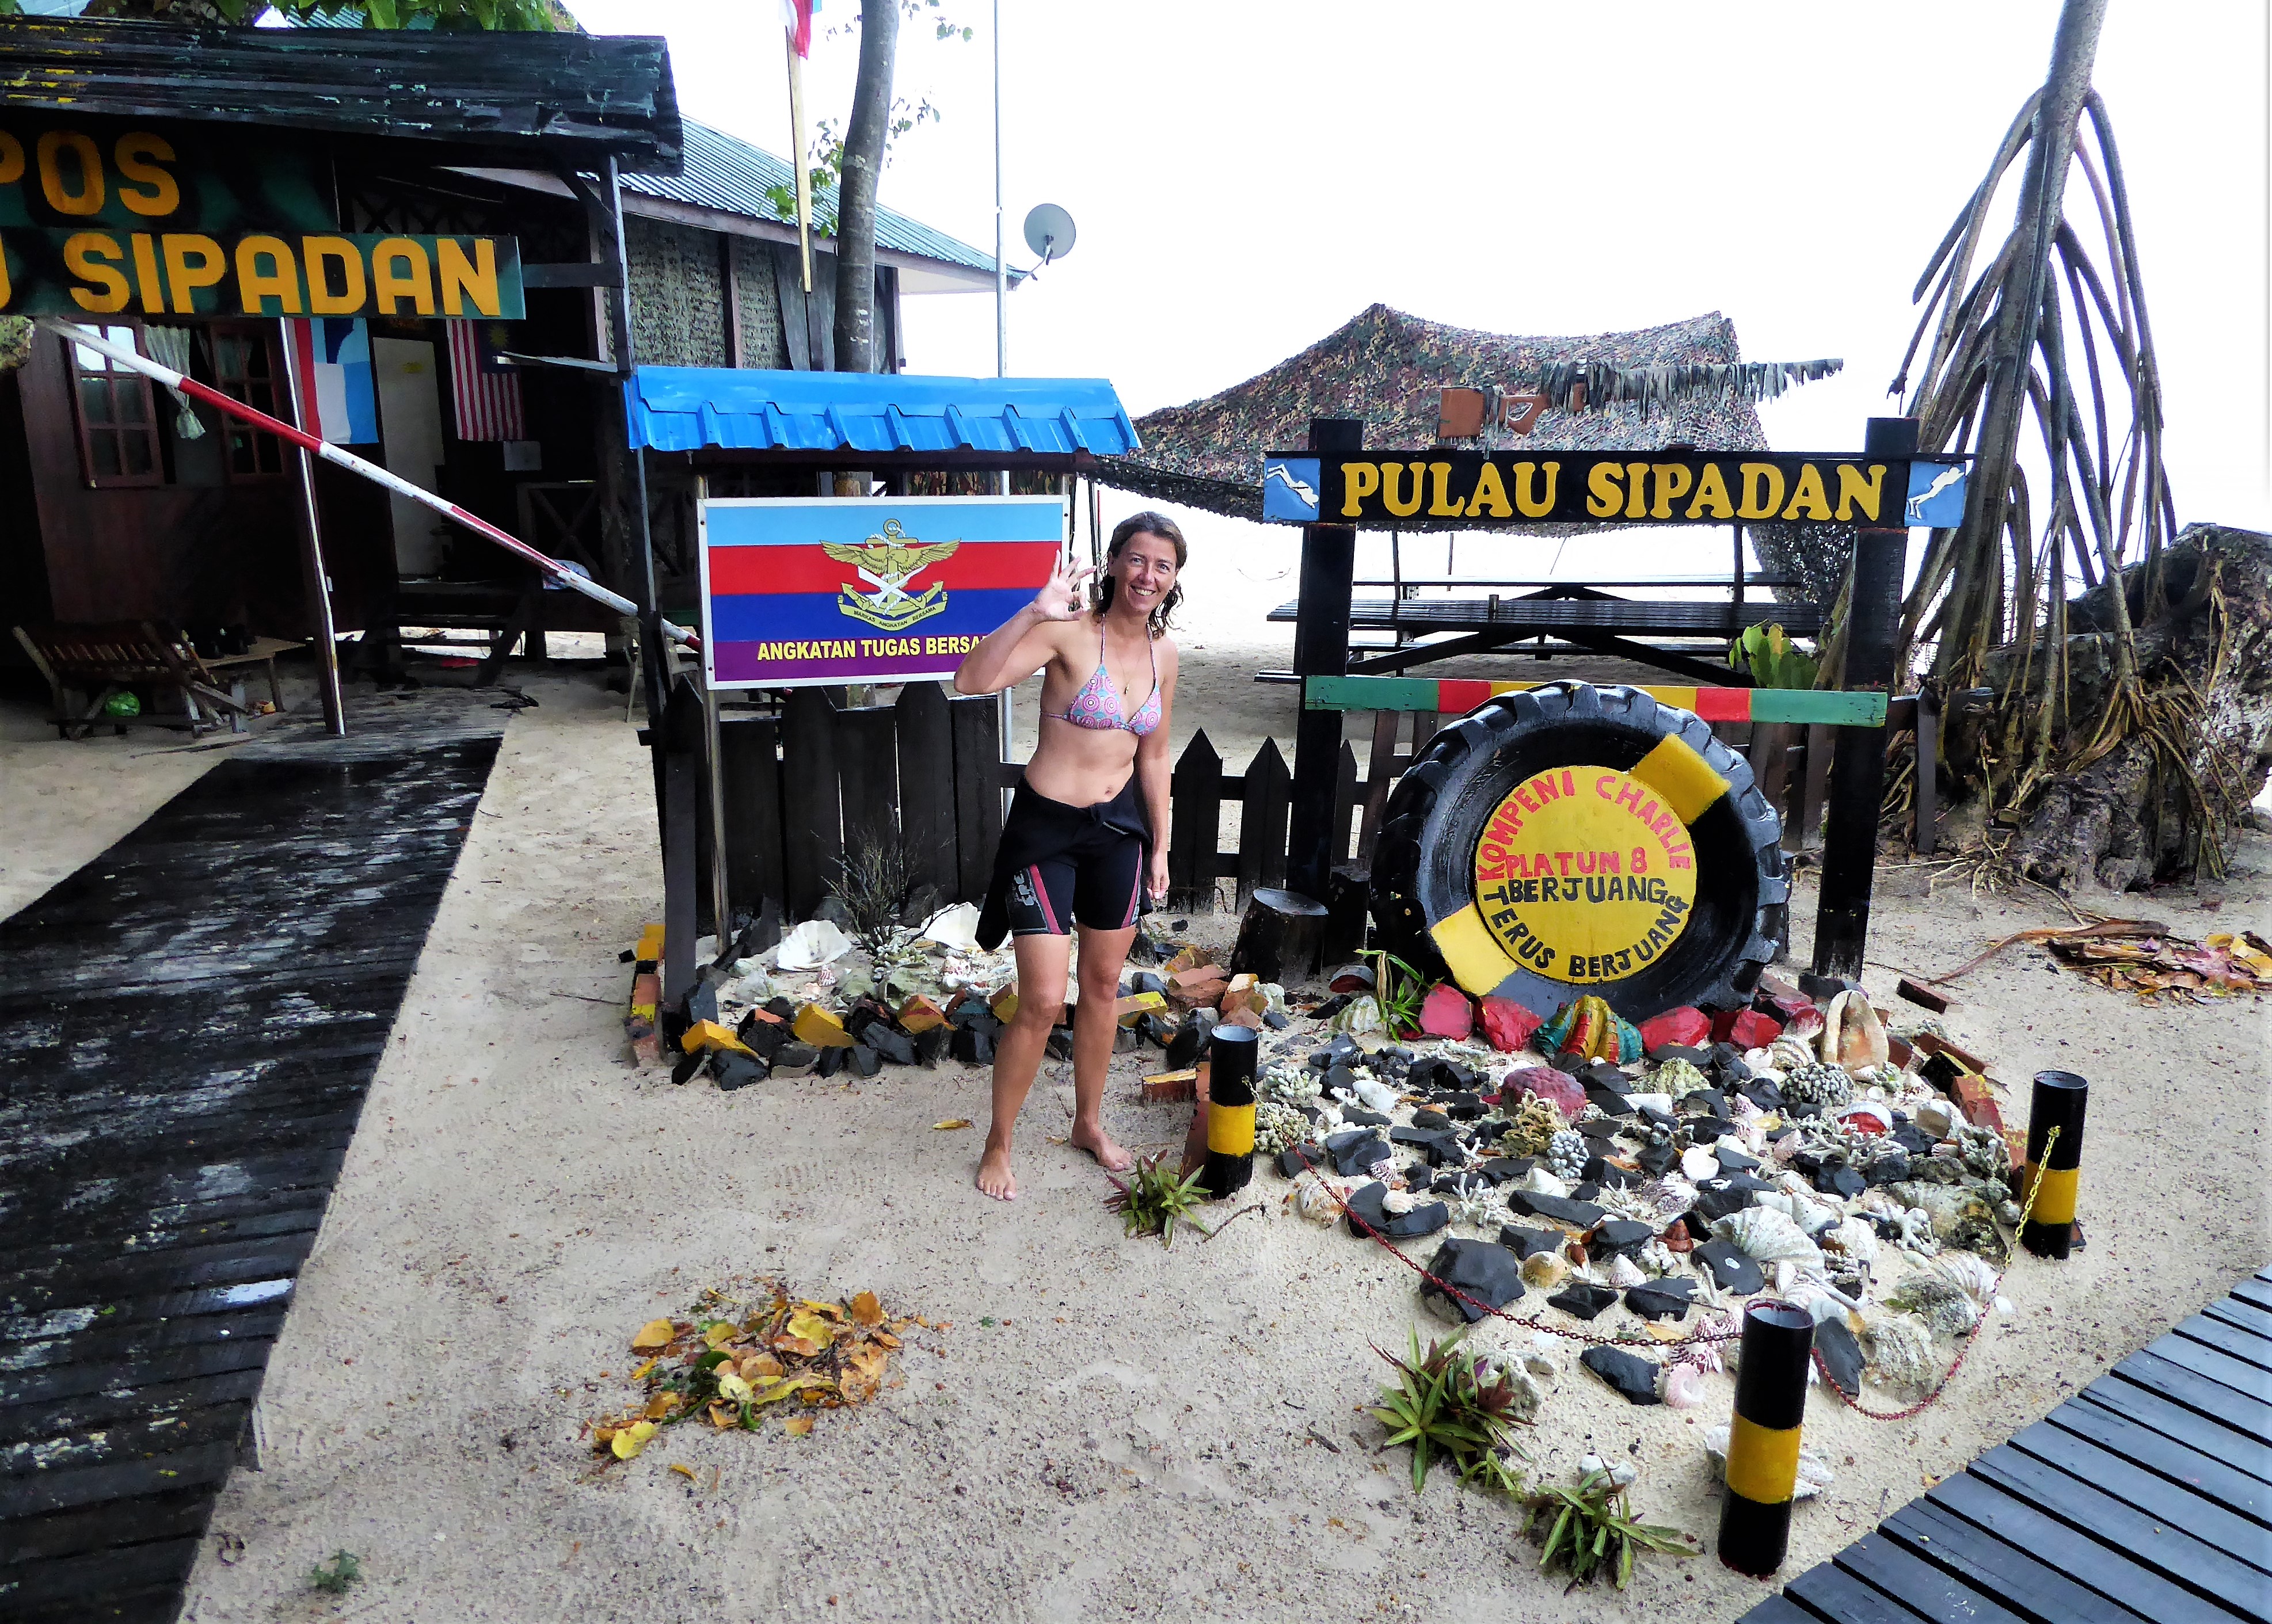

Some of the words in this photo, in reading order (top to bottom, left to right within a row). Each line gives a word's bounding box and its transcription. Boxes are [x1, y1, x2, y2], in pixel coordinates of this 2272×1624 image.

[64, 232, 500, 315] SIPADAN
[1341, 462, 1560, 518] PULAU
[1586, 462, 1886, 521] SIPADAN
[854, 610, 876, 623] MARKAS
[878, 620, 908, 628] ANGKATAN
[912, 606, 937, 621] BERSAMA
[758, 641, 856, 661] ANGKATAN
[861, 638, 921, 657] TUGAS
[926, 636, 987, 655] BERSA
[1477, 770, 1575, 881] KOMPENI
[1596, 775, 1691, 870] CHARLIE
[1505, 851, 1621, 879] PLATUN
[1630, 846, 1647, 874] 8
[1508, 875, 1669, 905] BERJUANG
[1483, 885, 1556, 970] TERUS
[1568, 895, 1690, 978] BERJUANG
